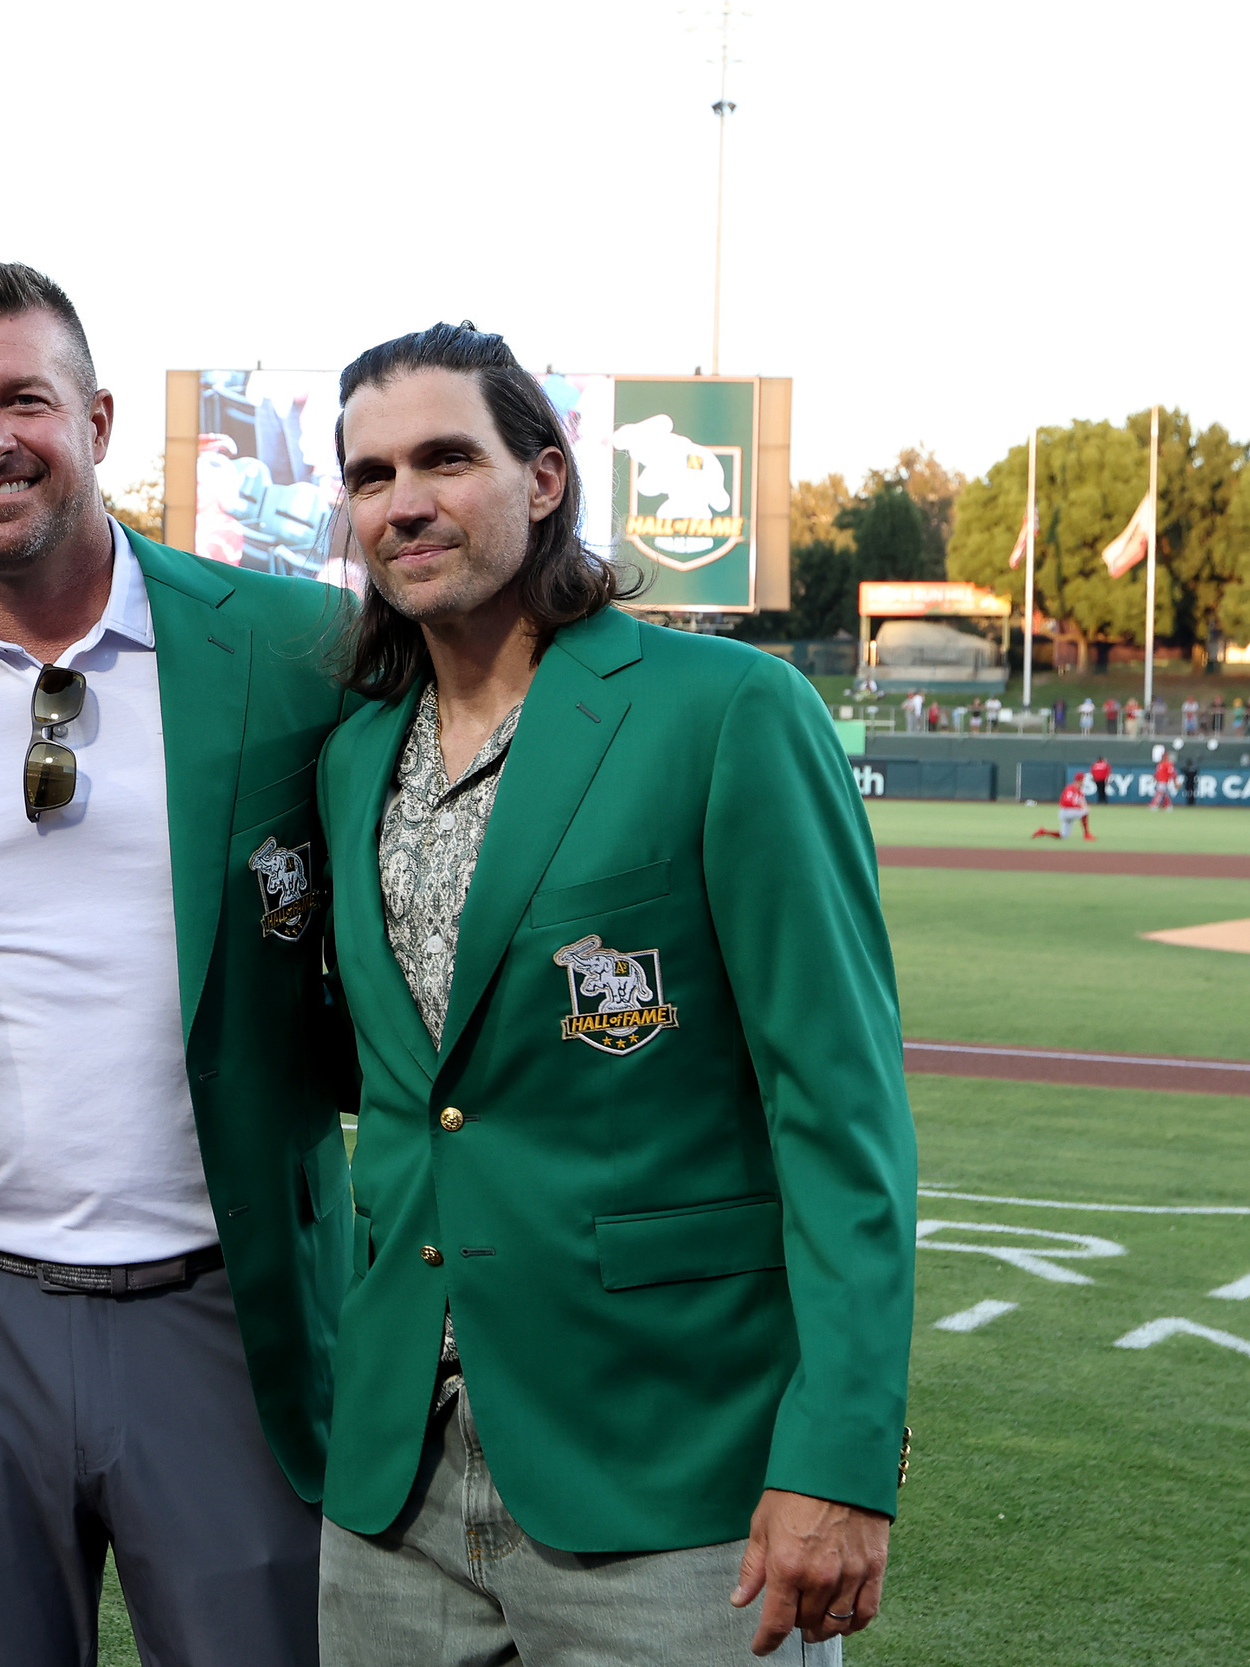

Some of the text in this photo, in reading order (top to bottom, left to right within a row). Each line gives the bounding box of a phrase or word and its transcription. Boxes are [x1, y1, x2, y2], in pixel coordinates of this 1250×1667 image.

[626, 515, 674, 536] HALL
[688, 516, 744, 537] FAME
[1138, 773, 1218, 799] RVR
[615, 961, 628, 974] A's
[572, 1007, 668, 1032] HALL of FAME
